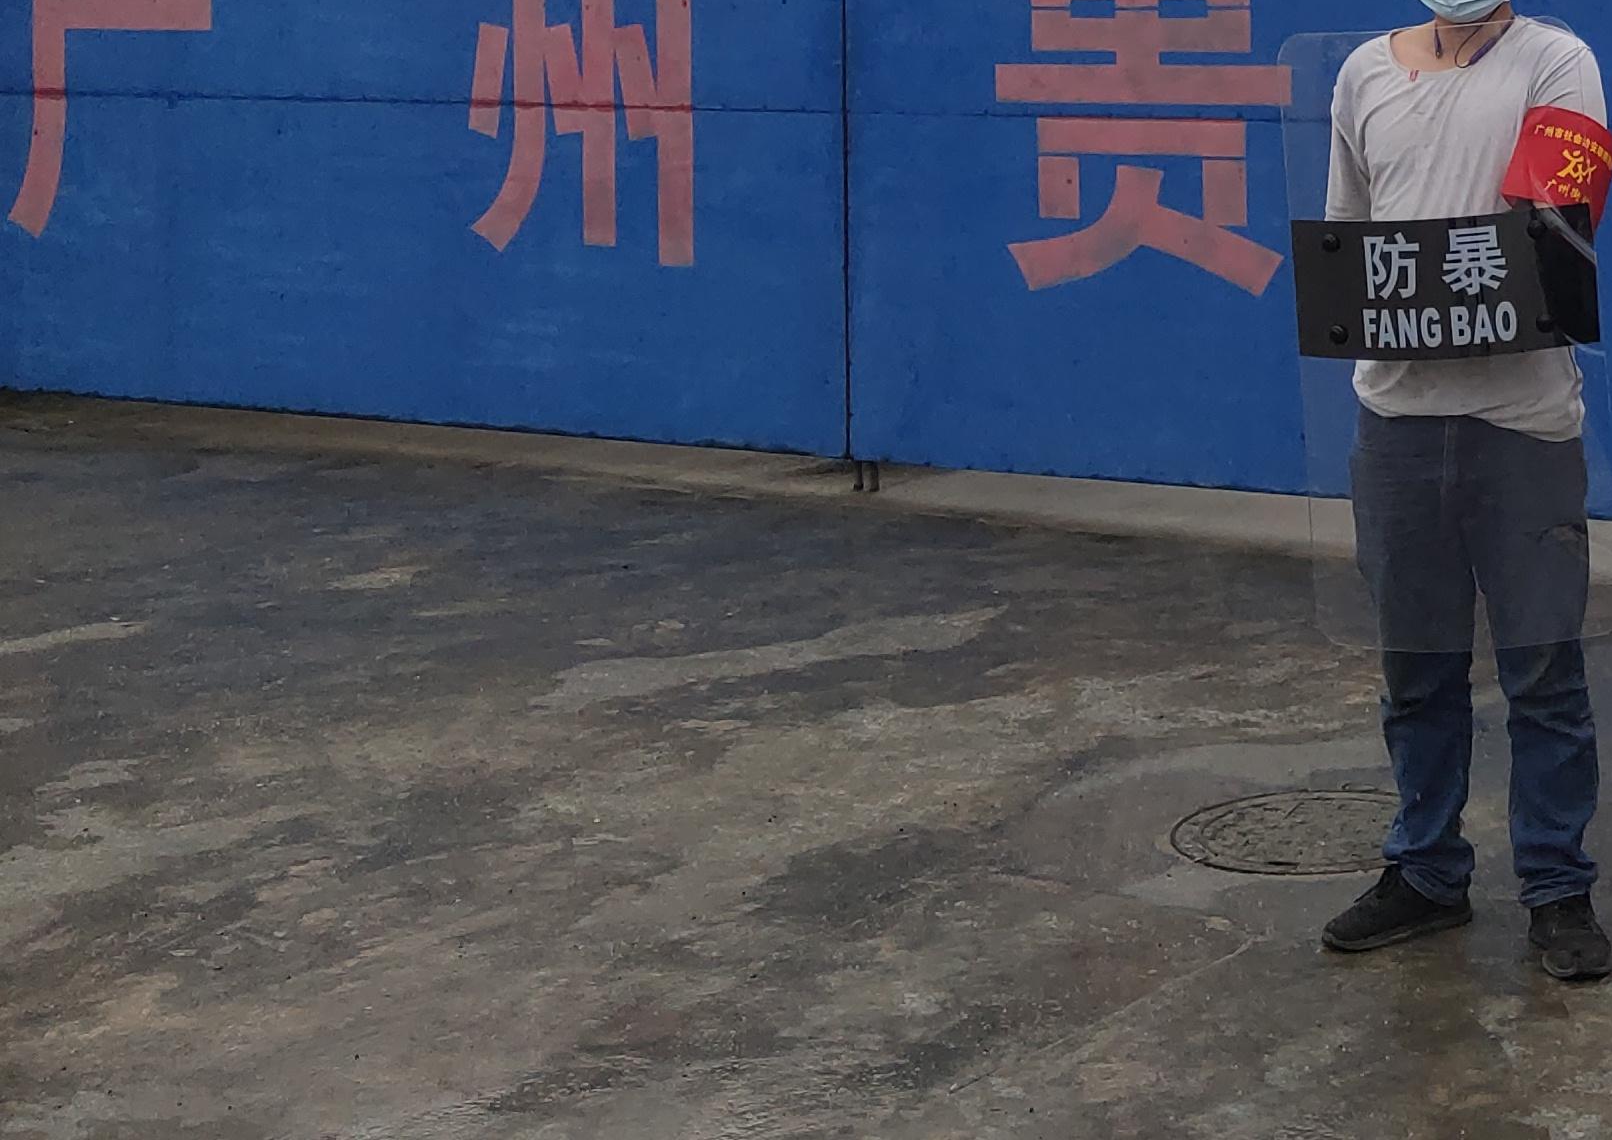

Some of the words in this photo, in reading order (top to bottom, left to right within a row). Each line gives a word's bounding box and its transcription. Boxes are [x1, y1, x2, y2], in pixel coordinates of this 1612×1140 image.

[1362, 225, 1509, 301] 防暴
[1362, 307, 1442, 349] FANG
[1450, 301, 1518, 347] BAO
